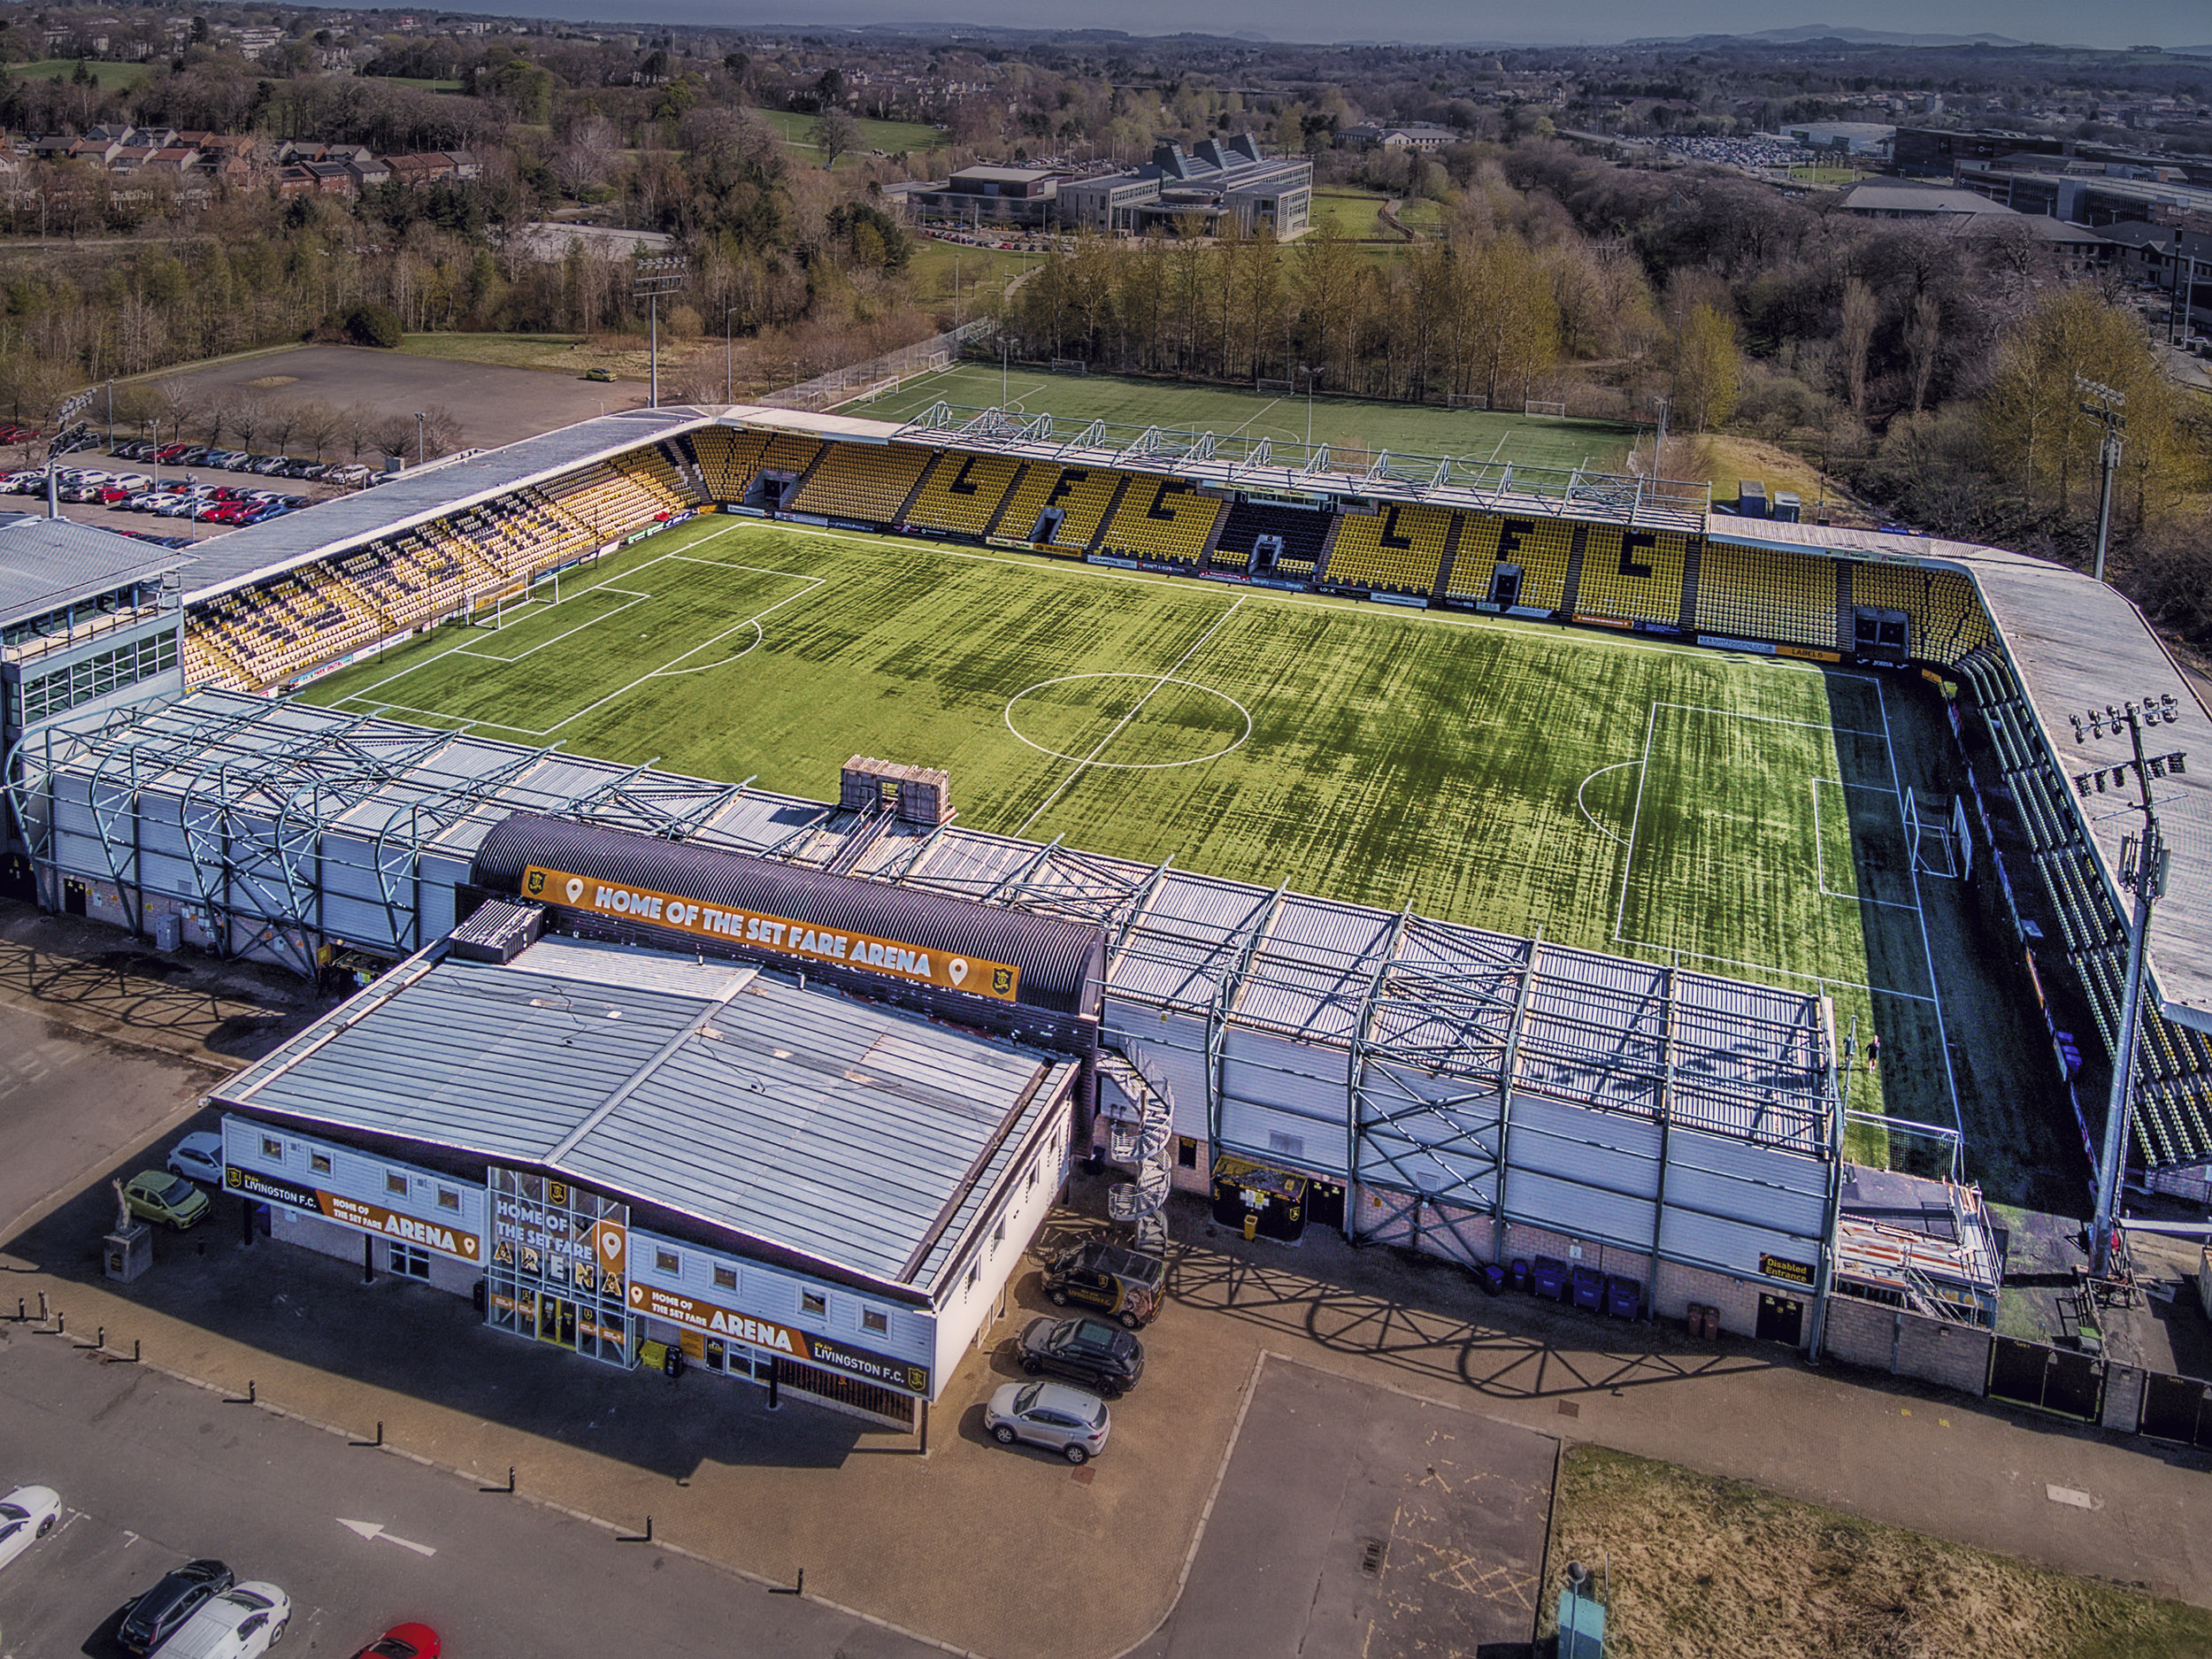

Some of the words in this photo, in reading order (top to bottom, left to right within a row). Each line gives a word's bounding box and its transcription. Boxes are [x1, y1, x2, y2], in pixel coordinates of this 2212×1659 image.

[1094, 557, 1119, 565] CAPITAL
[1792, 649, 1817, 658] LABEL
[595, 886, 663, 920] HOME
[665, 901, 700, 927] OF
[702, 909, 744, 937] THE
[746, 918, 787, 945] SET
[788, 926, 848, 959] FARE
[849, 940, 932, 978] ARENA
[244, 1179, 297, 1202] LIVINGSTON
[299, 1194, 317, 1208] F.C.
[333, 1197, 357, 1213] HOME
[357, 1204, 370, 1216] OF
[334, 1208, 348, 1221] THE
[348, 1212, 363, 1225] SET
[363, 1217, 382, 1230] FARE
[496, 1200, 542, 1225] HOME
[546, 1215, 568, 1233] OF
[384, 1214, 457, 1253] ARENA
[496, 1221, 525, 1241] THE
[526, 1230, 552, 1248] SET
[555, 1238, 593, 1261] FARE
[494, 1240, 623, 1297] ARENA
[1765, 1266, 1807, 1282] Entrance
[1767, 1258, 1807, 1274] Disabled
[651, 1291, 679, 1308] HOME
[680, 1299, 694, 1310] OF
[1068, 1288, 1102, 1304] LIVINGSTON
[651, 1302, 668, 1316] THE
[668, 1307, 684, 1320] SET
[685, 1312, 707, 1327] FARE
[709, 1310, 794, 1353] ARENA
[814, 1347, 880, 1377] LIVINGSTON
[883, 1367, 904, 1384] F.C.
